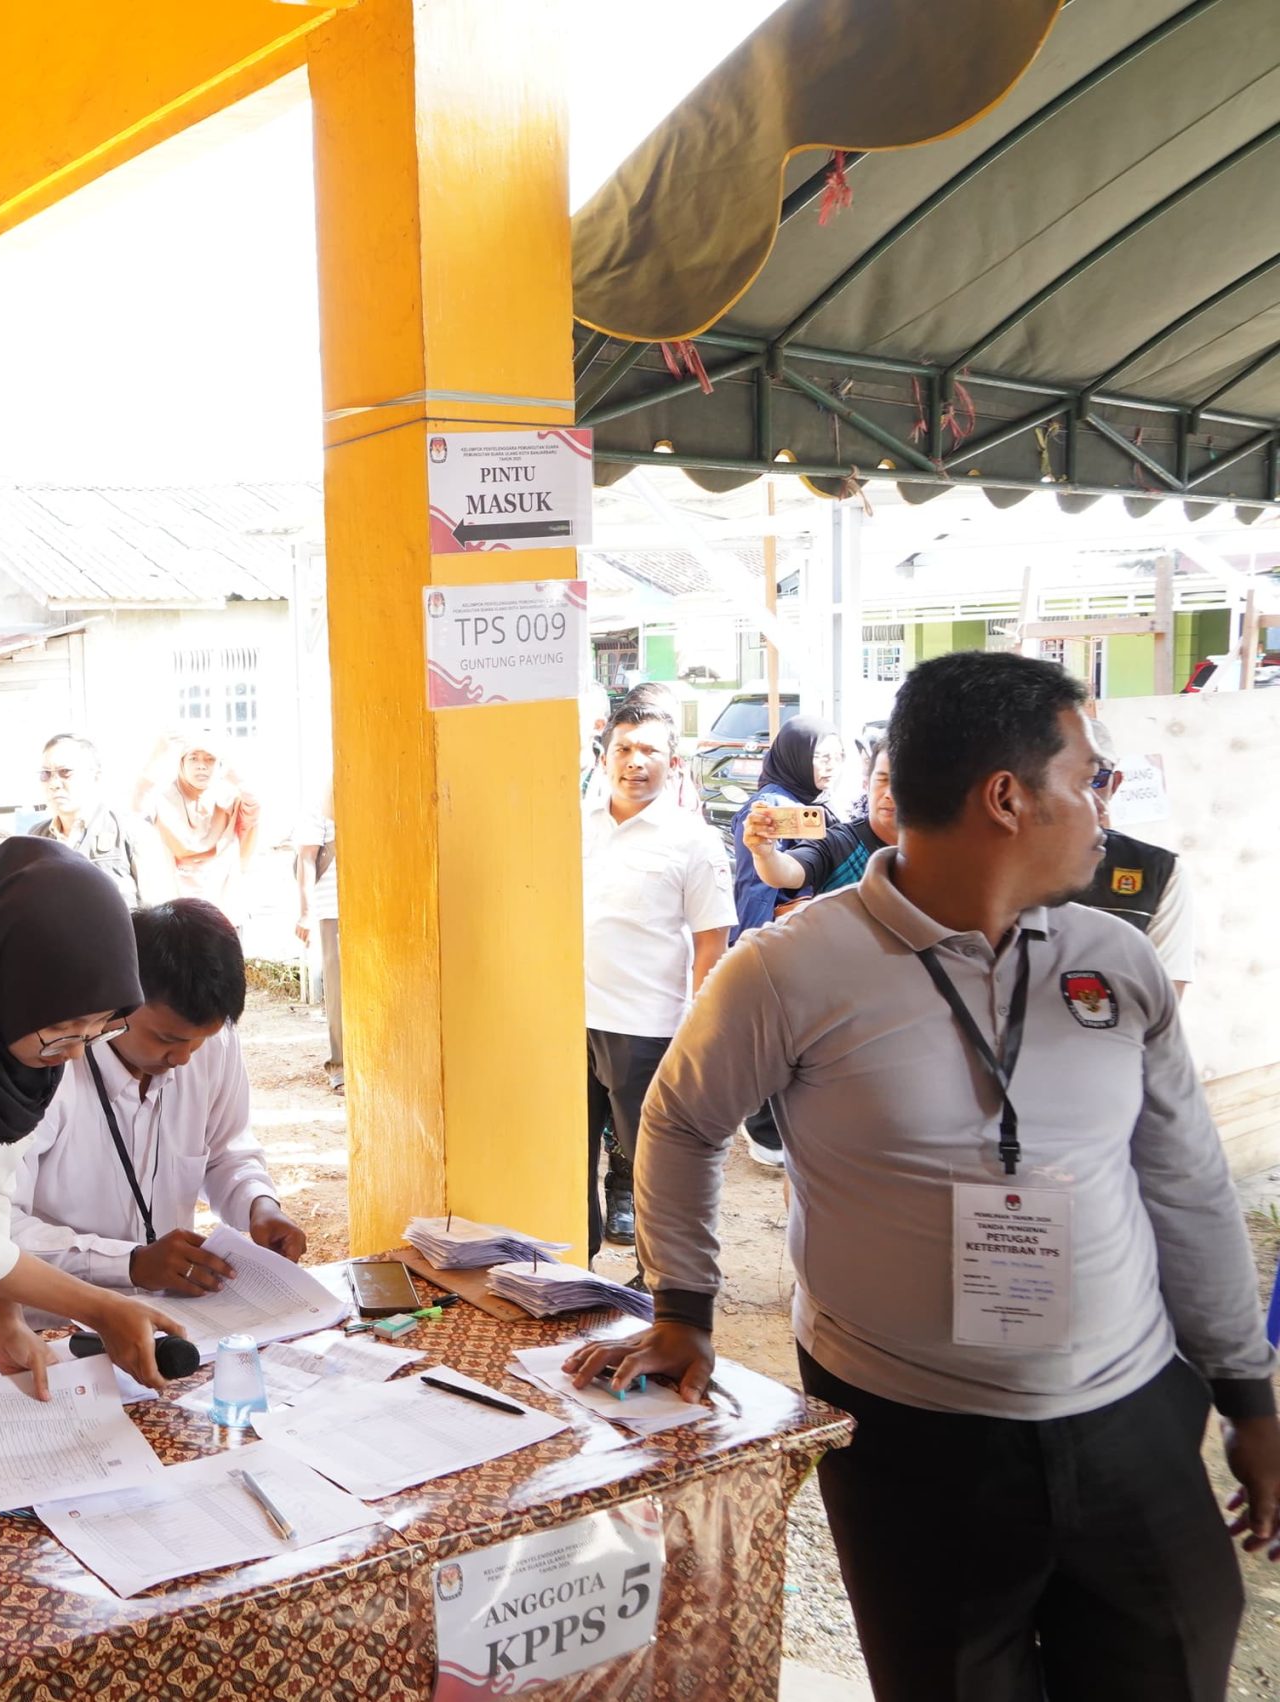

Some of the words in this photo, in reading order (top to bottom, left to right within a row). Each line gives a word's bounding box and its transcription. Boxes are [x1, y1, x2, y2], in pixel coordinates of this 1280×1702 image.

[480, 466, 536, 483] PINTU
[465, 491, 553, 515] MASUK
[454, 616, 506, 646] TPS
[516, 612, 566, 642] 009
[460, 656, 516, 671] GUNTUNG
[519, 652, 563, 666] PAYUNG
[1125, 768, 1153, 782] UANG
[977, 1222, 1005, 1230] TANDA
[986, 1232, 1039, 1244] PETUGAS
[965, 1242, 1036, 1255] KETERTIBAN
[1039, 1247, 1061, 1257] TPS
[483, 1571, 606, 1629] ANGGOTA
[485, 1604, 607, 1678] KPPS
[617, 1562, 651, 1619] 5
